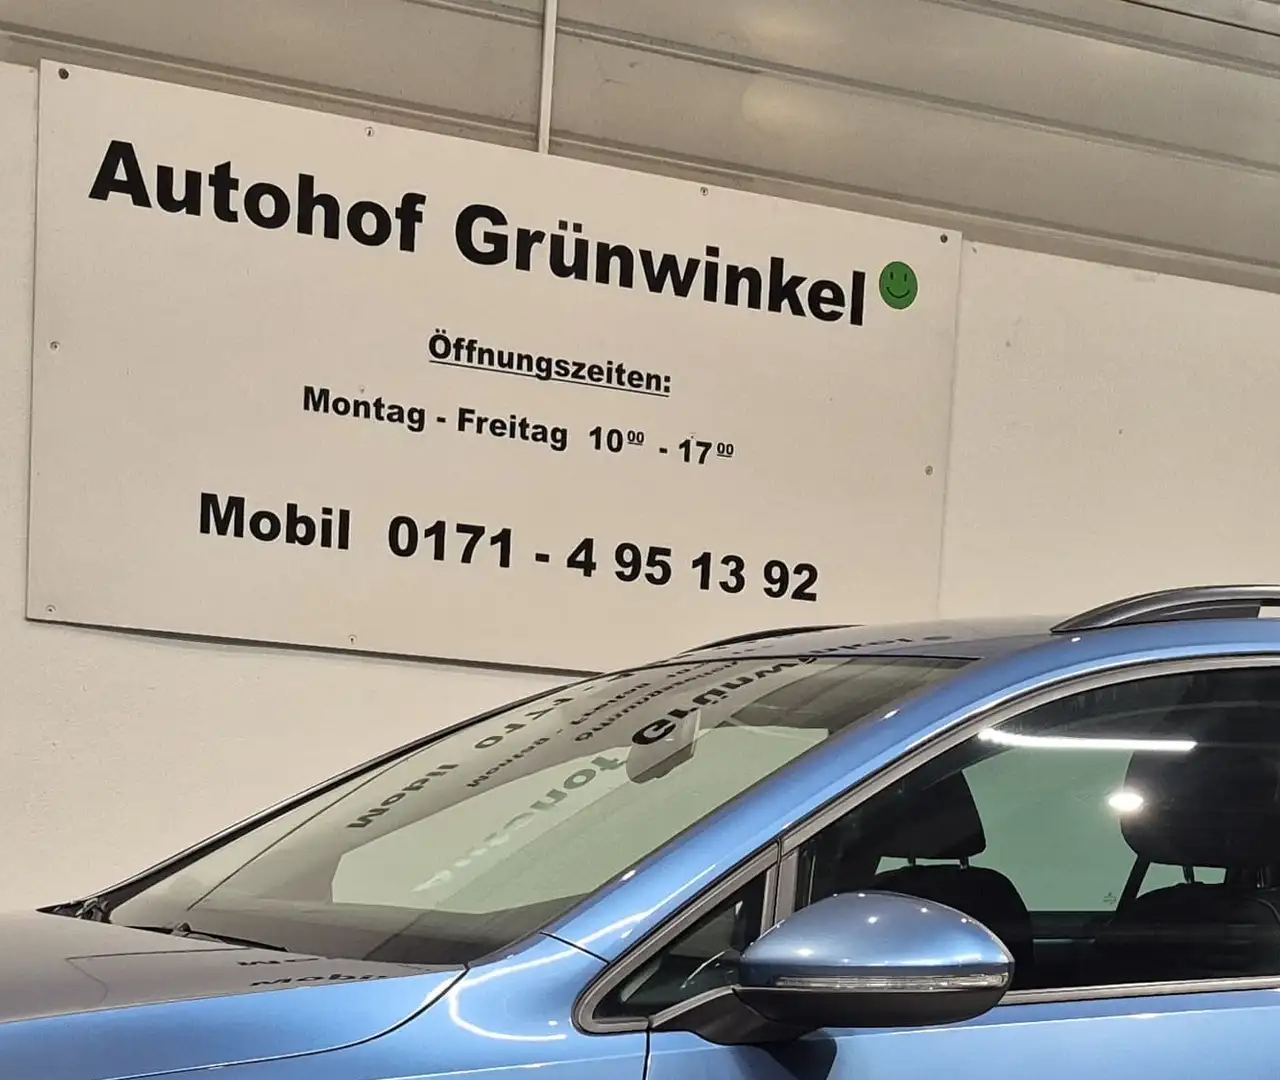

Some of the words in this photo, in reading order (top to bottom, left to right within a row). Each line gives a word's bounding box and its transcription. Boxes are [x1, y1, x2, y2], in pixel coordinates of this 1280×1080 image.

[88, 139, 426, 253] Autohof
[455, 203, 866, 327] Grünwinkel
[428, 329, 671, 397] Öffnungszeiten:
[303, 385, 426, 433] Montag
[457, 407, 568, 452] Freitag
[199, 492, 351, 551] Mobil
[388, 515, 513, 569] 0171
[566, 537, 597, 578] 4
[614, 542, 672, 586] 95
[691, 551, 746, 594] 13
[763, 559, 818, 602] 92
